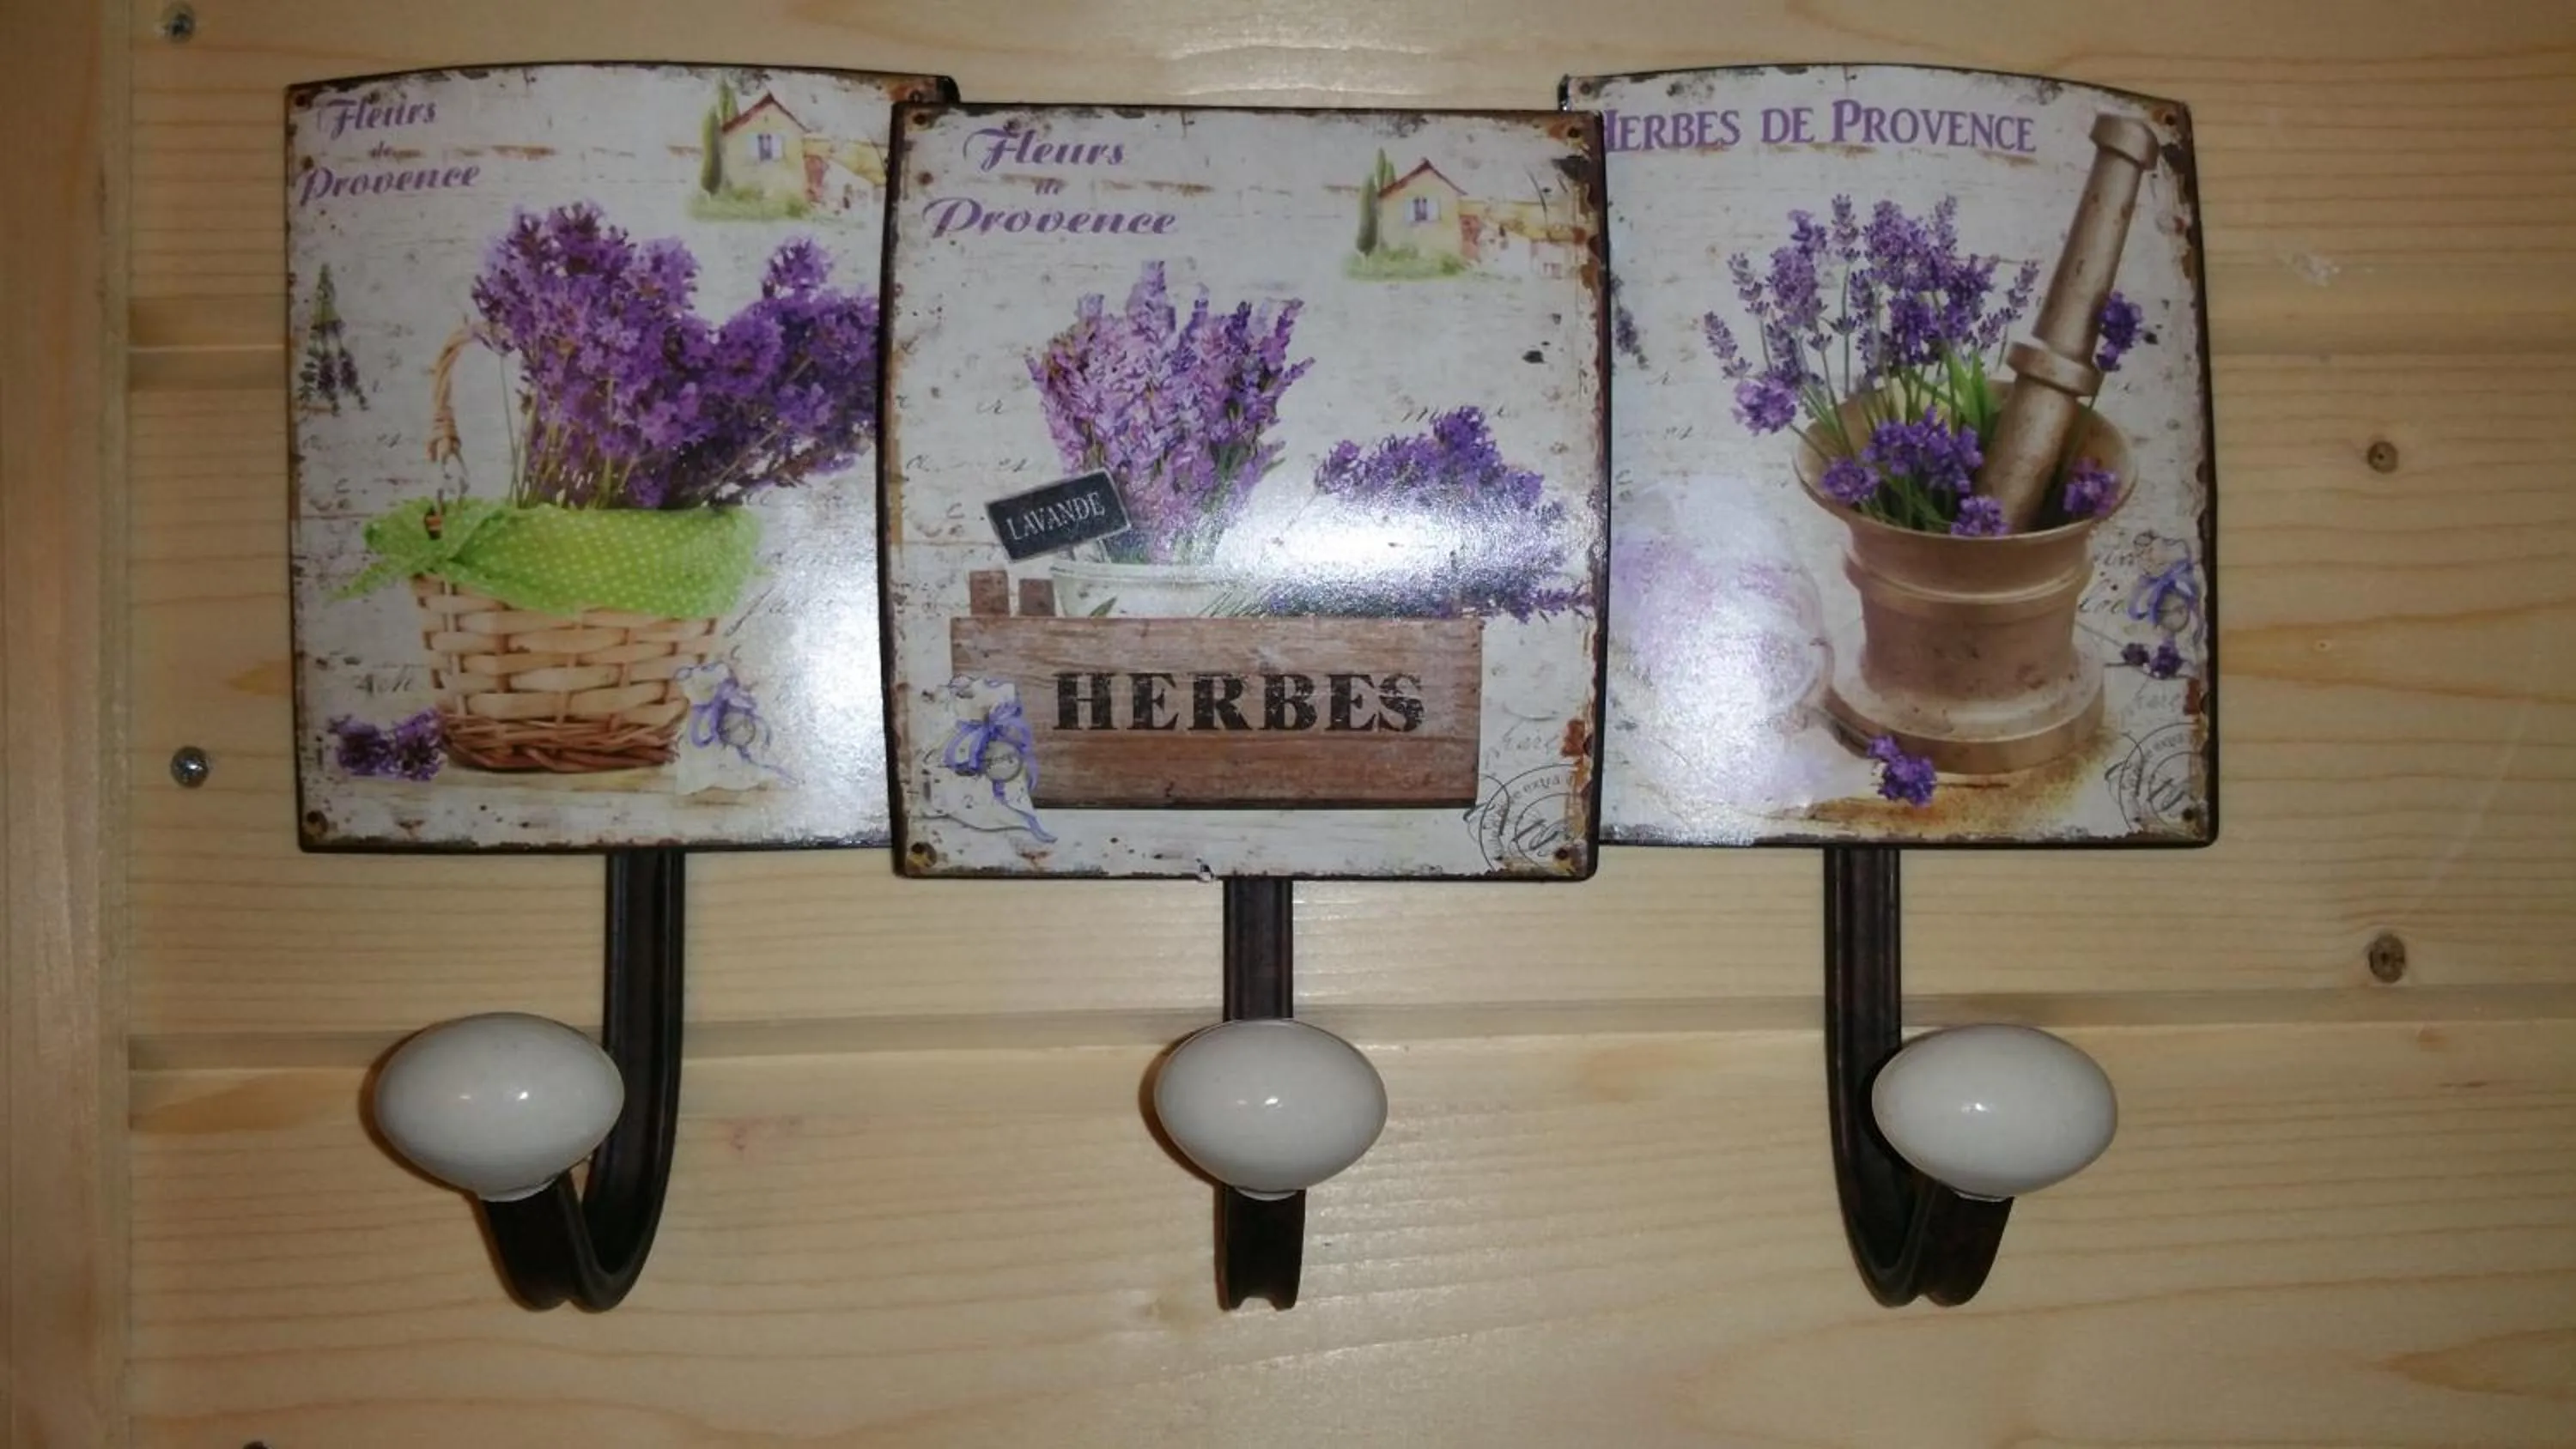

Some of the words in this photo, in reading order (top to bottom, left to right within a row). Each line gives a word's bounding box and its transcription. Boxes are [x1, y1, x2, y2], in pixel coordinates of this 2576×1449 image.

[318, 99, 437, 139] Fleurs
[1760, 106, 1814, 144] DE
[1831, 99, 2037, 154] PROVENCE
[963, 127, 1125, 172] Fleurs
[300, 166, 480, 207] Provence
[922, 197, 1177, 239] Provence
[1005, 491, 1105, 541] LAVANDE
[1052, 671, 1426, 733] HERBES
